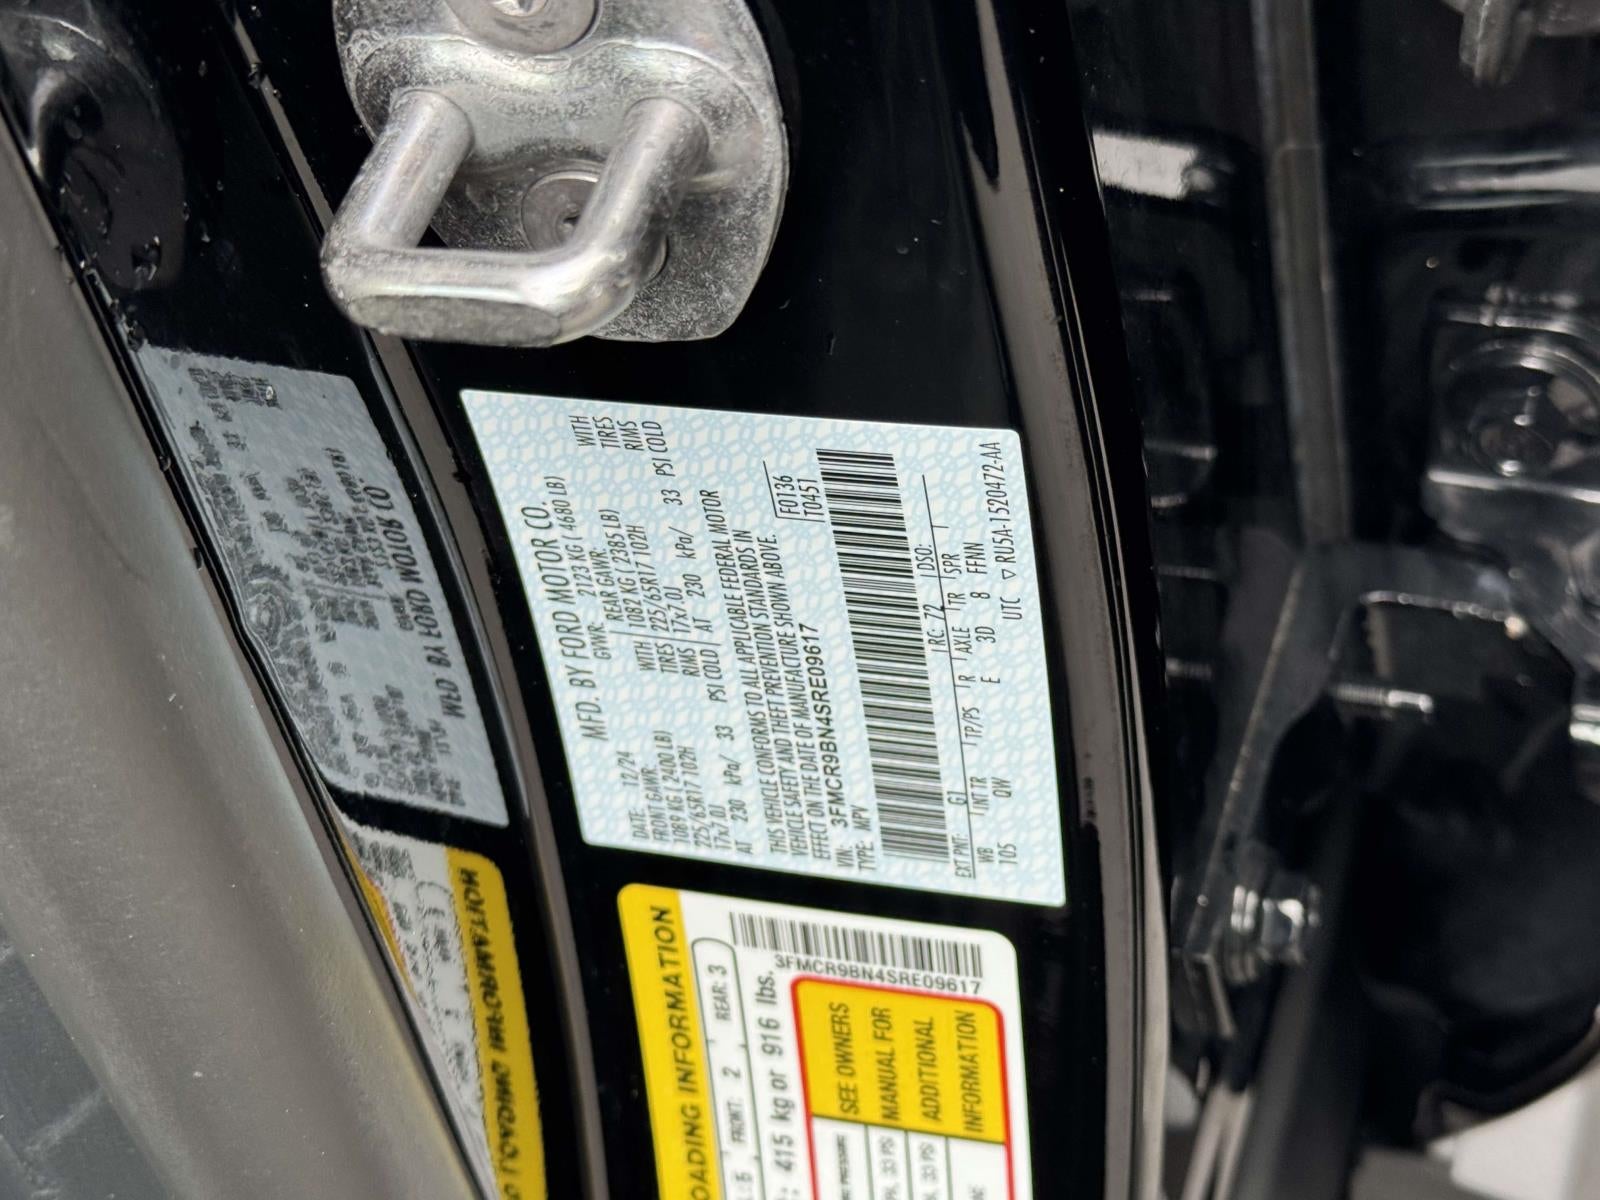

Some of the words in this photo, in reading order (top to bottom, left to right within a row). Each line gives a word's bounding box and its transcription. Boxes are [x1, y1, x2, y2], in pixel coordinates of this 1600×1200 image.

[569, 415, 596, 447] WITH
[592, 415, 621, 449] TIRES
[616, 419, 644, 450] RIMS
[641, 420, 668, 452] COLD
[652, 457, 675, 476] PSI
[543, 475, 568, 495] LB)
[660, 489, 682, 505] 33
[772, 474, 800, 514] F0136
[796, 477, 824, 517] T0451
[518, 499, 554, 530] CO.
[550, 499, 578, 530] 4680
[699, 488, 728, 534] MOTOR
[978, 441, 1015, 563] RU5A-1520472-AA
[598, 508, 623, 528] LB)
[605, 532, 631, 564] 2385
[625, 524, 651, 556] 102H
[668, 526, 698, 559] kPa/
[731, 529, 753, 542] IN
[565, 543, 586, 561] KG
[587, 546, 615, 587] GAWR:
[710, 538, 741, 590] FEDERAL
[756, 532, 784, 578] ABOVE.
[913, 542, 934, 570] DSO:
[941, 552, 961, 574] SPR
[963, 542, 987, 574] FFNN
[529, 536, 576, 605] MOTOR
[571, 565, 596, 597] 2123
[616, 576, 638, 594] KG
[682, 573, 705, 597] 230
[735, 546, 769, 619] STANDARDS
[599, 590, 624, 621] REAR
[635, 561, 671, 633] 225/65R17
[663, 585, 691, 633] 17x7.0J
[766, 581, 794, 627] SHOWN
[947, 592, 966, 606] TR
[969, 591, 990, 599] 8
[1000, 596, 1022, 620] UTC
[622, 597, 647, 628] 1082
[693, 616, 712, 632] AT
[923, 603, 944, 620] 72
[550, 610, 589, 659] FORD
[584, 620, 612, 660] GVWR:
[723, 593, 756, 664] APPLICABLE
[926, 628, 946, 645] RC:
[951, 626, 972, 653] AXLE
[974, 625, 996, 643] 3D
[632, 640, 657, 672] WITH
[655, 642, 679, 674] TIRES
[676, 646, 700, 676] RIMS
[699, 648, 723, 679] COLD
[752, 622, 784, 696] PREVENTION
[564, 664, 597, 688] BY
[738, 667, 760, 688] ALL
[775, 630, 811, 719] MANUFACTURE
[706, 683, 727, 702] PSI
[743, 691, 764, 707] TO
[571, 694, 610, 741] MFD.
[714, 724, 734, 740] 33
[766, 698, 790, 735] THEFT
[793, 721, 813, 738] OF
[795, 622, 851, 828] 3FMCR9BN4SRE09617
[961, 705, 984, 739] TP/PS
[652, 728, 675, 749] LB)
[745, 709, 777, 775] CONFORMS
[773, 737, 795, 763] AND
[612, 749, 641, 787] 12/24
[655, 751, 680, 783] 2400
[675, 745, 700, 776] 102H
[718, 754, 744, 785] kPa/
[795, 740, 819, 771] DATE
[777, 766, 802, 807] SAFETY
[800, 774, 822, 796] THE
[946, 789, 967, 806] G1
[970, 775, 987, 789] TR
[991, 776, 1012, 798] QW
[665, 794, 684, 811] KG
[679, 777, 715, 848] 225/65R17
[728, 798, 749, 822] 230
[757, 778, 785, 824] VEHICLE
[804, 799, 825, 817] ON
[971, 791, 990, 809] INT
[645, 804, 671, 842] FRONT
[668, 814, 691, 844] 1089
[783, 809, 810, 857] VEHICLE
[850, 804, 872, 831] MPV
[735, 840, 753, 854] AT
[766, 826, 789, 854] THIS
[806, 820, 832, 860] EFFECT
[854, 839, 877, 871] TYPE:
[951, 832, 970, 856] PNT:
[977, 846, 994, 864] WB
[997, 841, 1018, 865] 105
[834, 844, 856, 869] VIN:
[953, 859, 972, 878] EXT
[707, 963, 727, 976] 3
[775, 953, 981, 994] 3FMCR9BN4SRE09617
[649, 904, 698, 1093] INFORMATION
[710, 980, 732, 1021] REAR:
[750, 967, 777, 1005] lbs.
[757, 1016, 783, 1056] 916
[869, 1005, 893, 1042] FOR
[828, 1001, 856, 1078] OWNERS
[721, 1065, 741, 1078] 2
[768, 1067, 787, 1091] or
[874, 1046, 901, 1121] MANUAL
[911, 1015, 942, 1121] ADDITIONAL
[953, 1009, 985, 1133] INFORMATION
[767, 1095, 796, 1122] kg
[837, 1080, 860, 1115] SEE
[771, 1132, 796, 1172] 415
